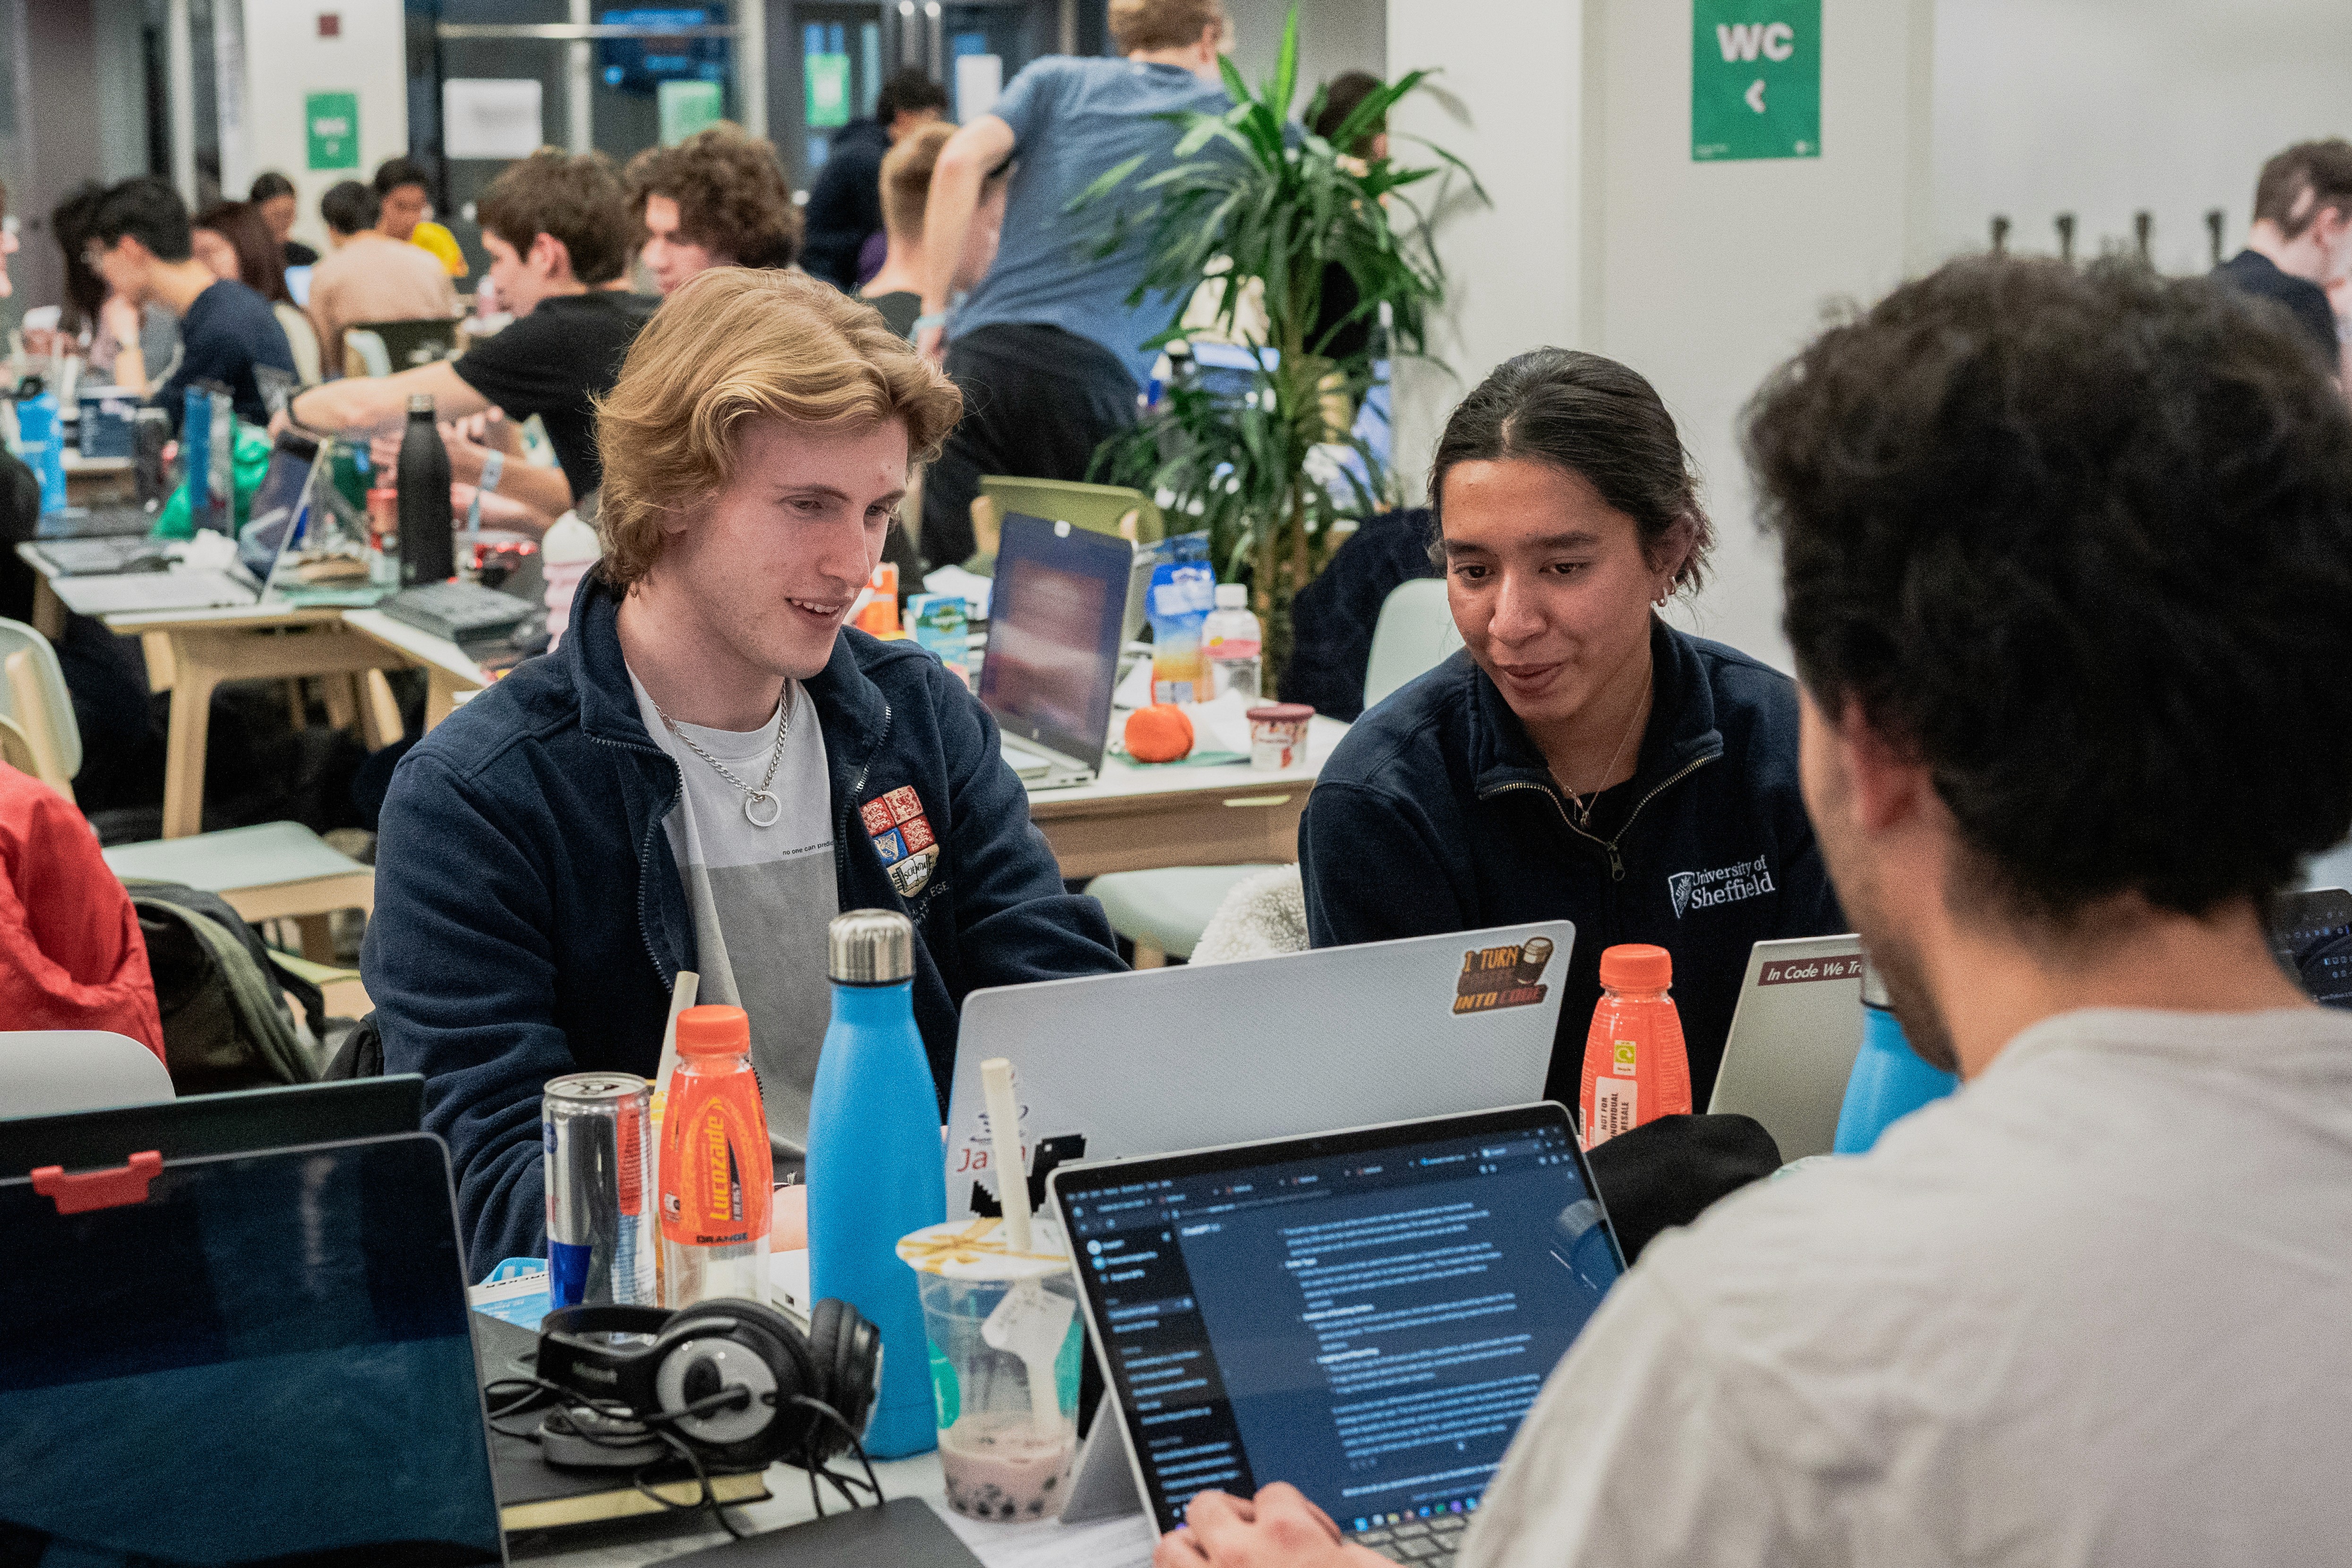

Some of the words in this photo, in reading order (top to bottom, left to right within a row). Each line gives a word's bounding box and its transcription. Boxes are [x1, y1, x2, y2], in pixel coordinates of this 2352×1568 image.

[1716, 22, 1794, 62] WC
[1693, 862, 1752, 886] University
[1754, 854, 1767, 871] of
[1692, 871, 1776, 909] Sheffield
[1464, 951, 1474, 972] I
[1481, 946, 1519, 970] TURN
[1767, 968, 1780, 981] In
[1784, 963, 1819, 979] Code
[1823, 962, 1844, 976] We
[1454, 992, 1498, 1011] INTO
[704, 1116, 730, 1221] Lucozade
[696, 1232, 749, 1244] ORANGE
